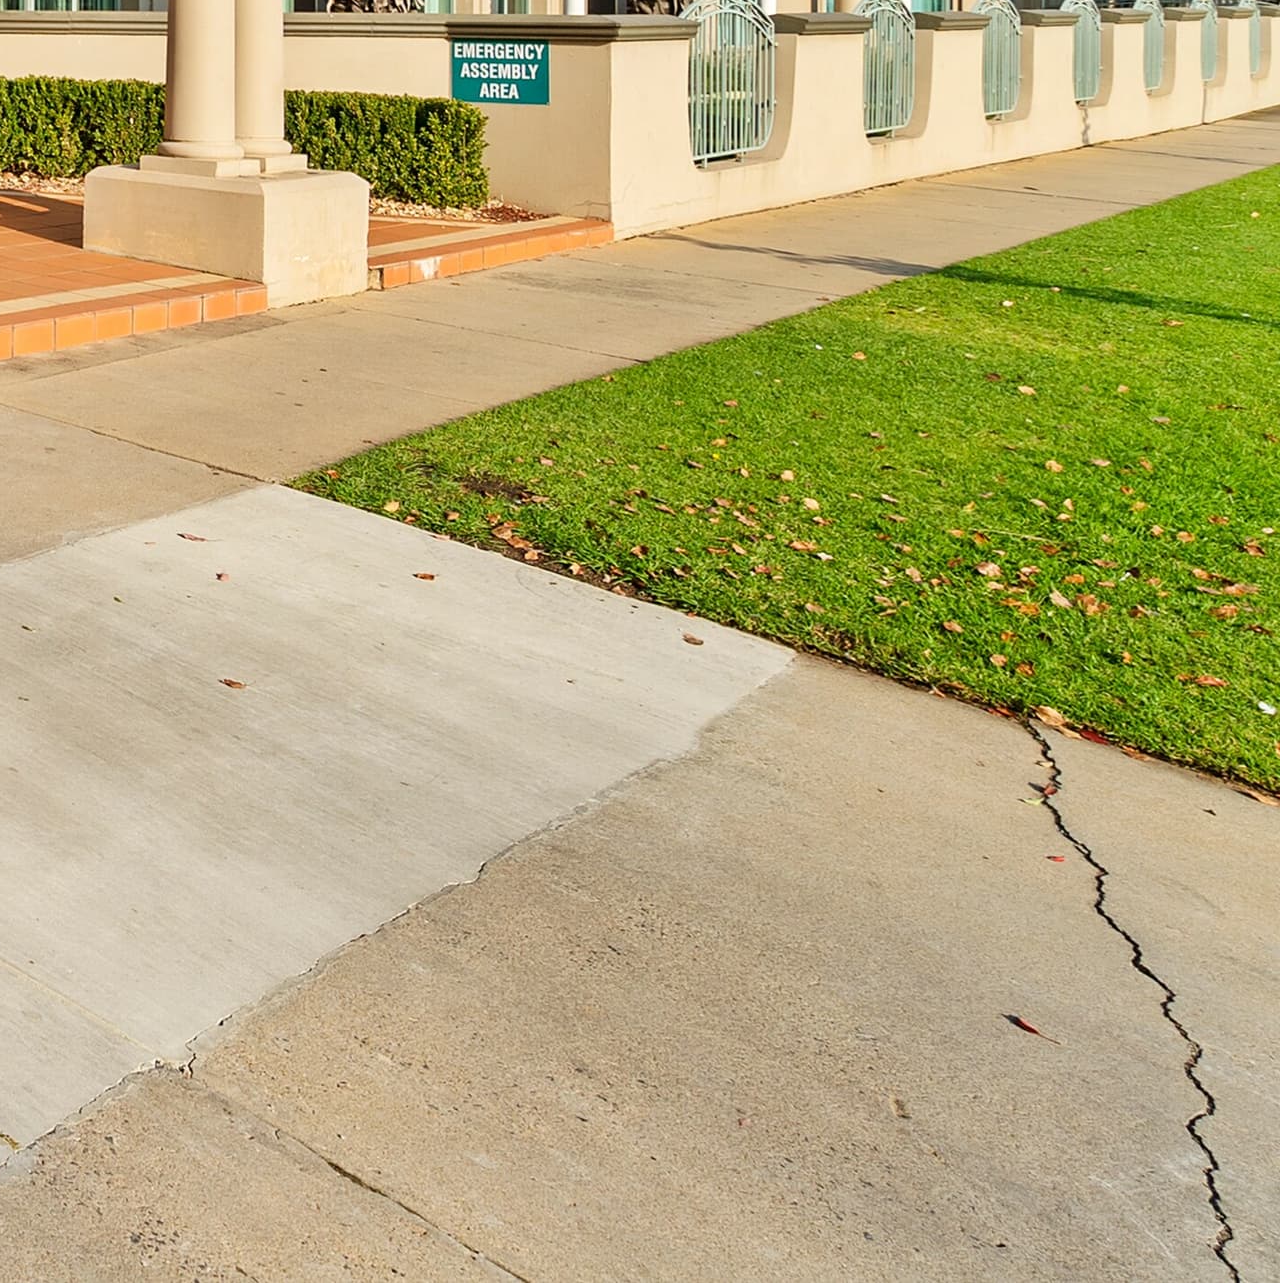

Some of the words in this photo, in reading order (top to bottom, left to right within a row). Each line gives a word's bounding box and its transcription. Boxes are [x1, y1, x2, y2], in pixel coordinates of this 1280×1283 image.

[453, 42, 545, 60] EMERGENCY
[460, 62, 539, 79] ASSEMBLY
[480, 82, 519, 99] AREA
